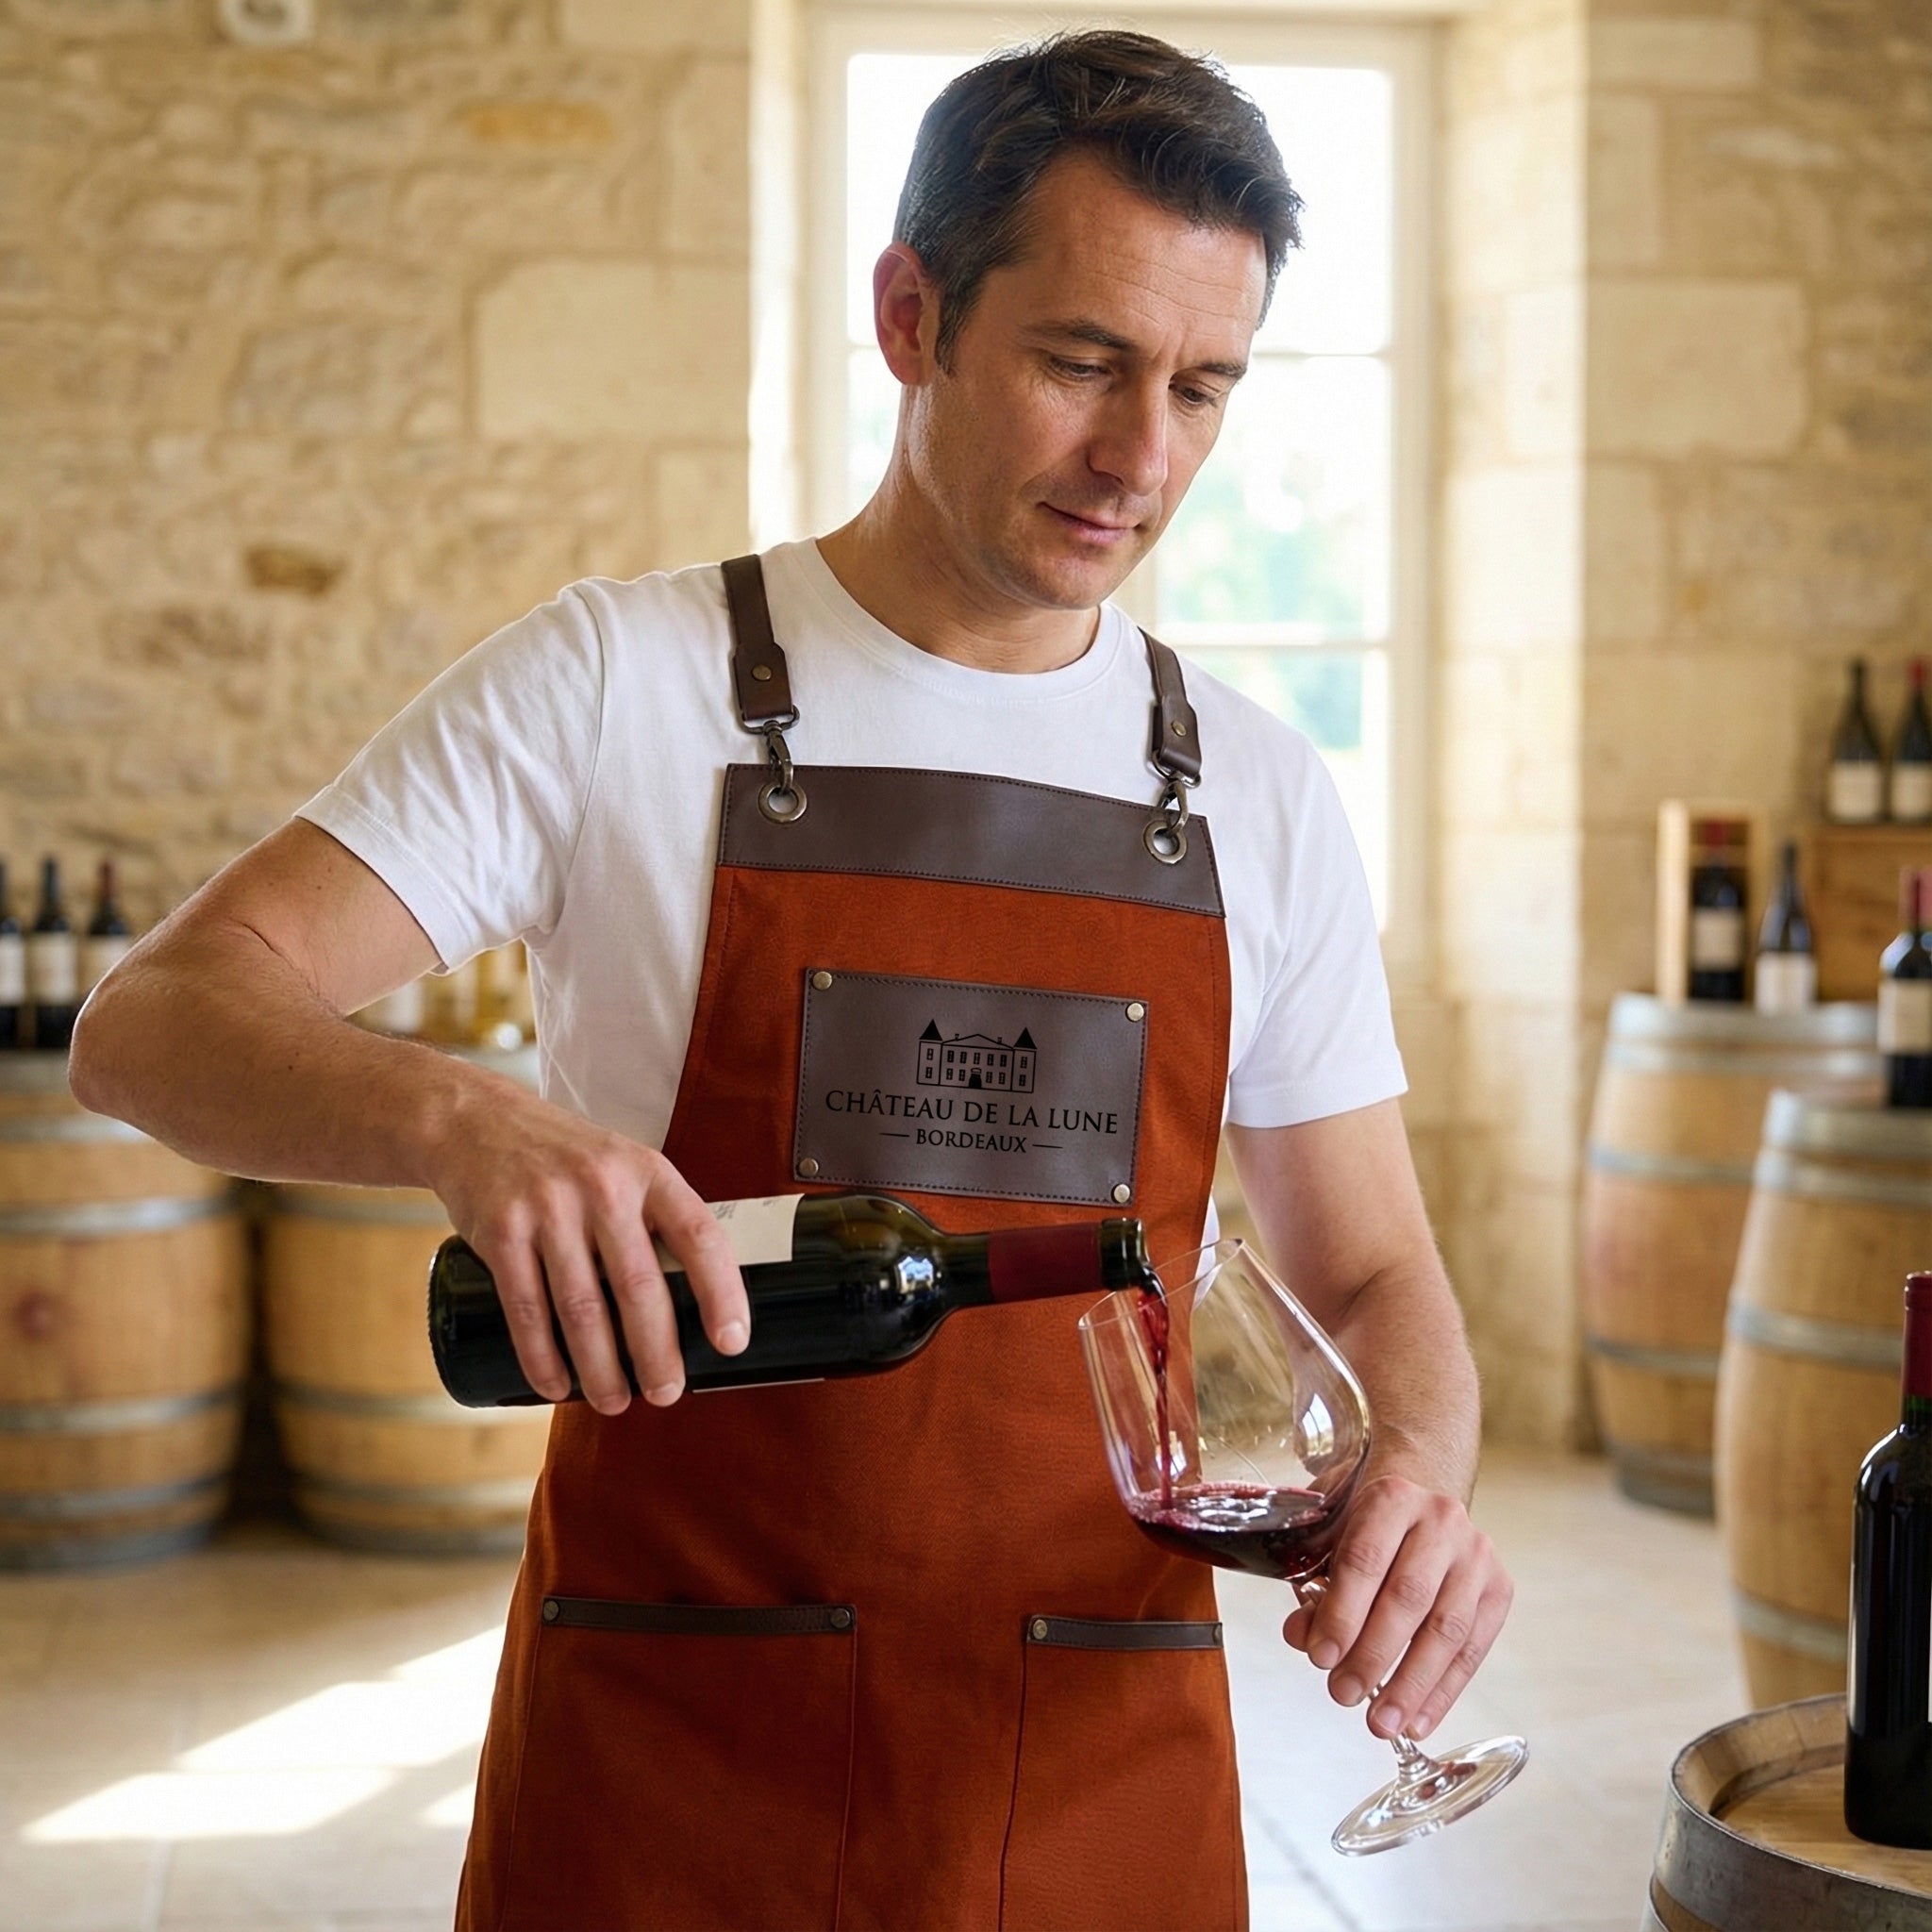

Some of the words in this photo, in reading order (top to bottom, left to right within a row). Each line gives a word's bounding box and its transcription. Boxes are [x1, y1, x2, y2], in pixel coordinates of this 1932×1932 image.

[825, 1090, 954, 1121] CHÂTEAU
[963, 1102, 997, 1124] DE
[1008, 1105, 1040, 1127] LA
[1048, 1108, 1118, 1134] LUNE
[916, 1128, 1027, 1153] BORDEAUX
